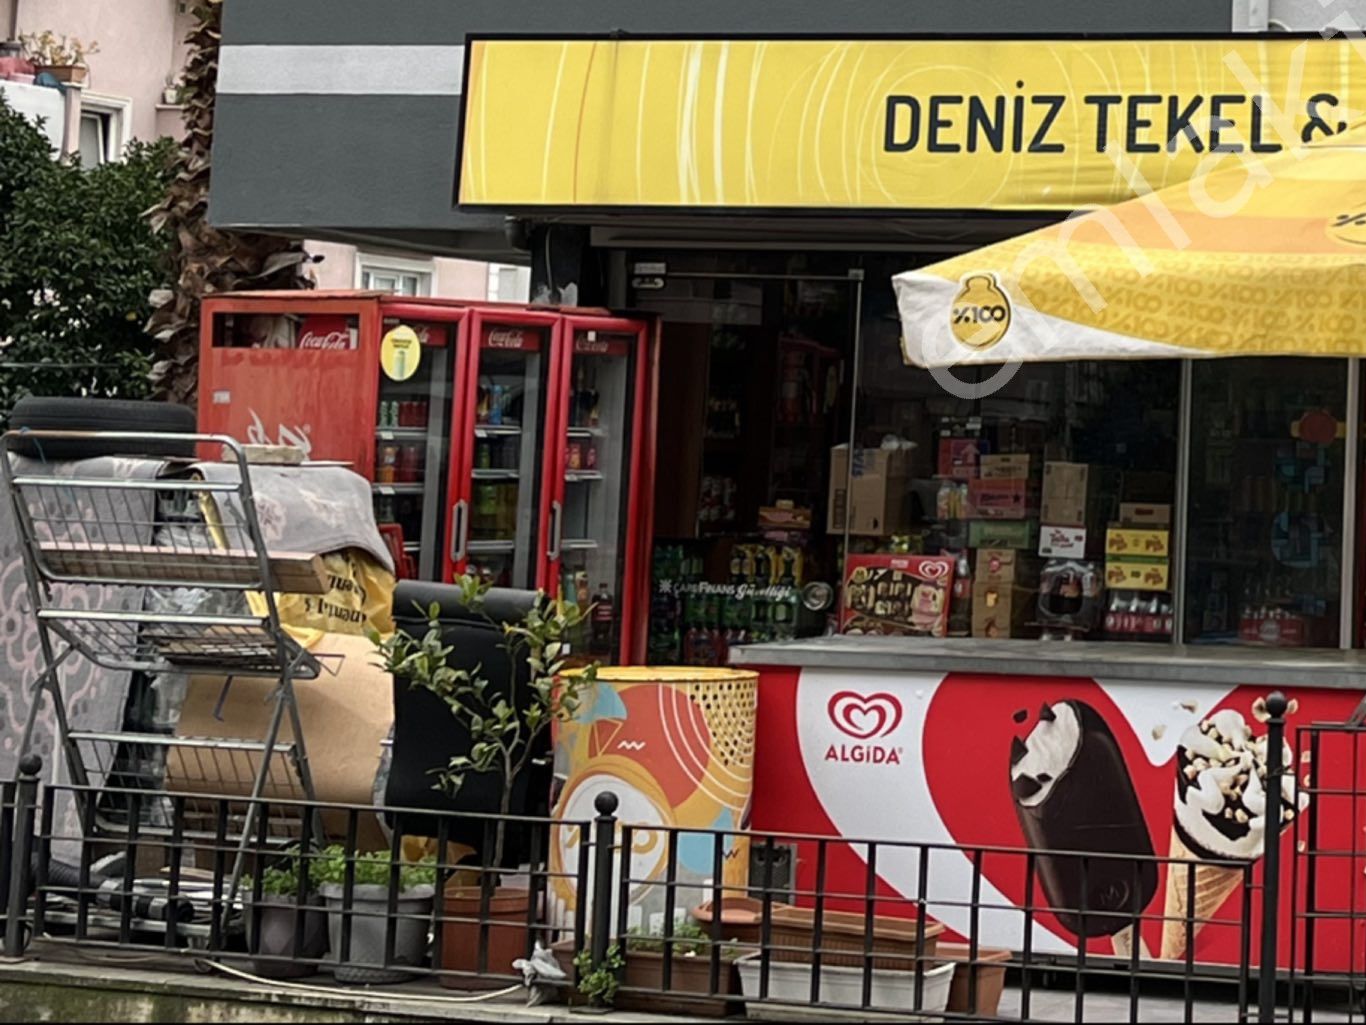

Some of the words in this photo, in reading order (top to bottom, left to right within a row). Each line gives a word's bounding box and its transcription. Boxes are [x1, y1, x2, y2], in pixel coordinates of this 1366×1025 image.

[883, 79, 1066, 153] DENİZ
[1084, 94, 1284, 154] TEKEL
[1300, 92, 1348, 144] &
[953, 305, 1006, 324] %100
